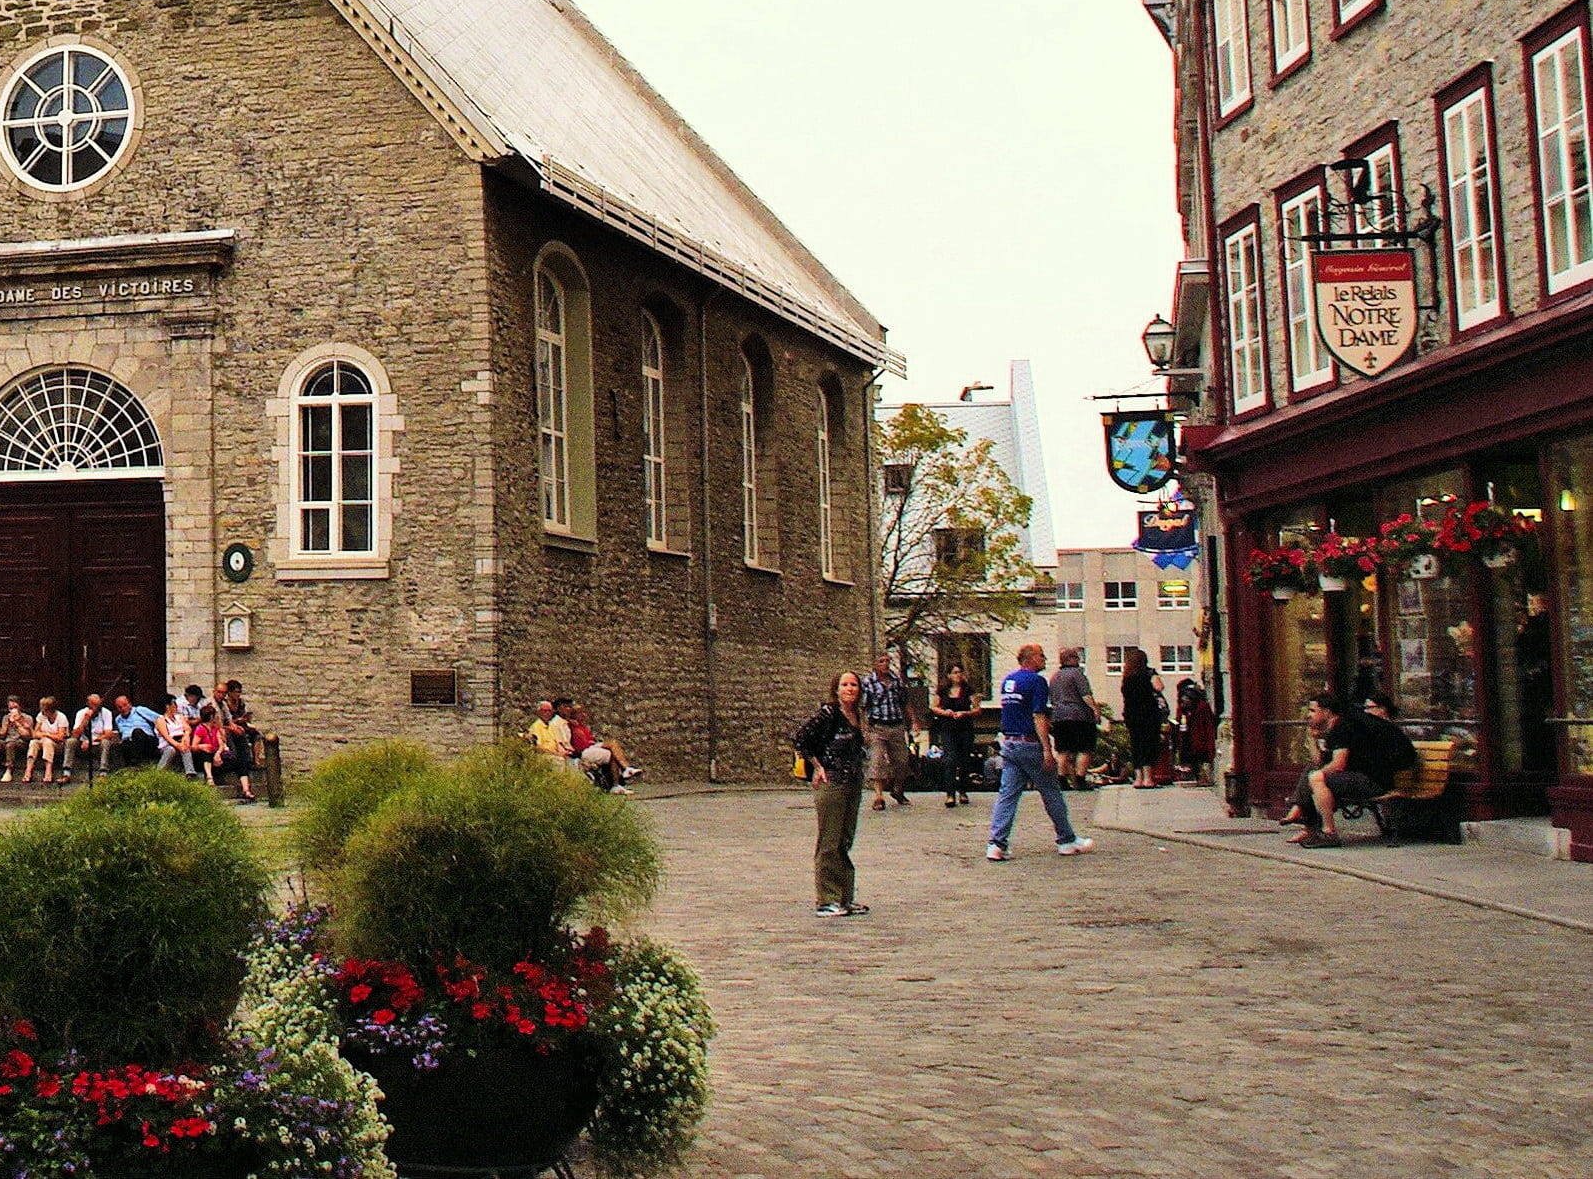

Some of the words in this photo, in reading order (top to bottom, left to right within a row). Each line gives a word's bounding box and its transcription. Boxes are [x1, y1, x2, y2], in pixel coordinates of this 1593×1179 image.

[51, 286, 83, 300] DES
[1350, 285, 1398, 307] Relais
[1328, 303, 1403, 329] NOTRE
[1338, 328, 1400, 348] DAME
